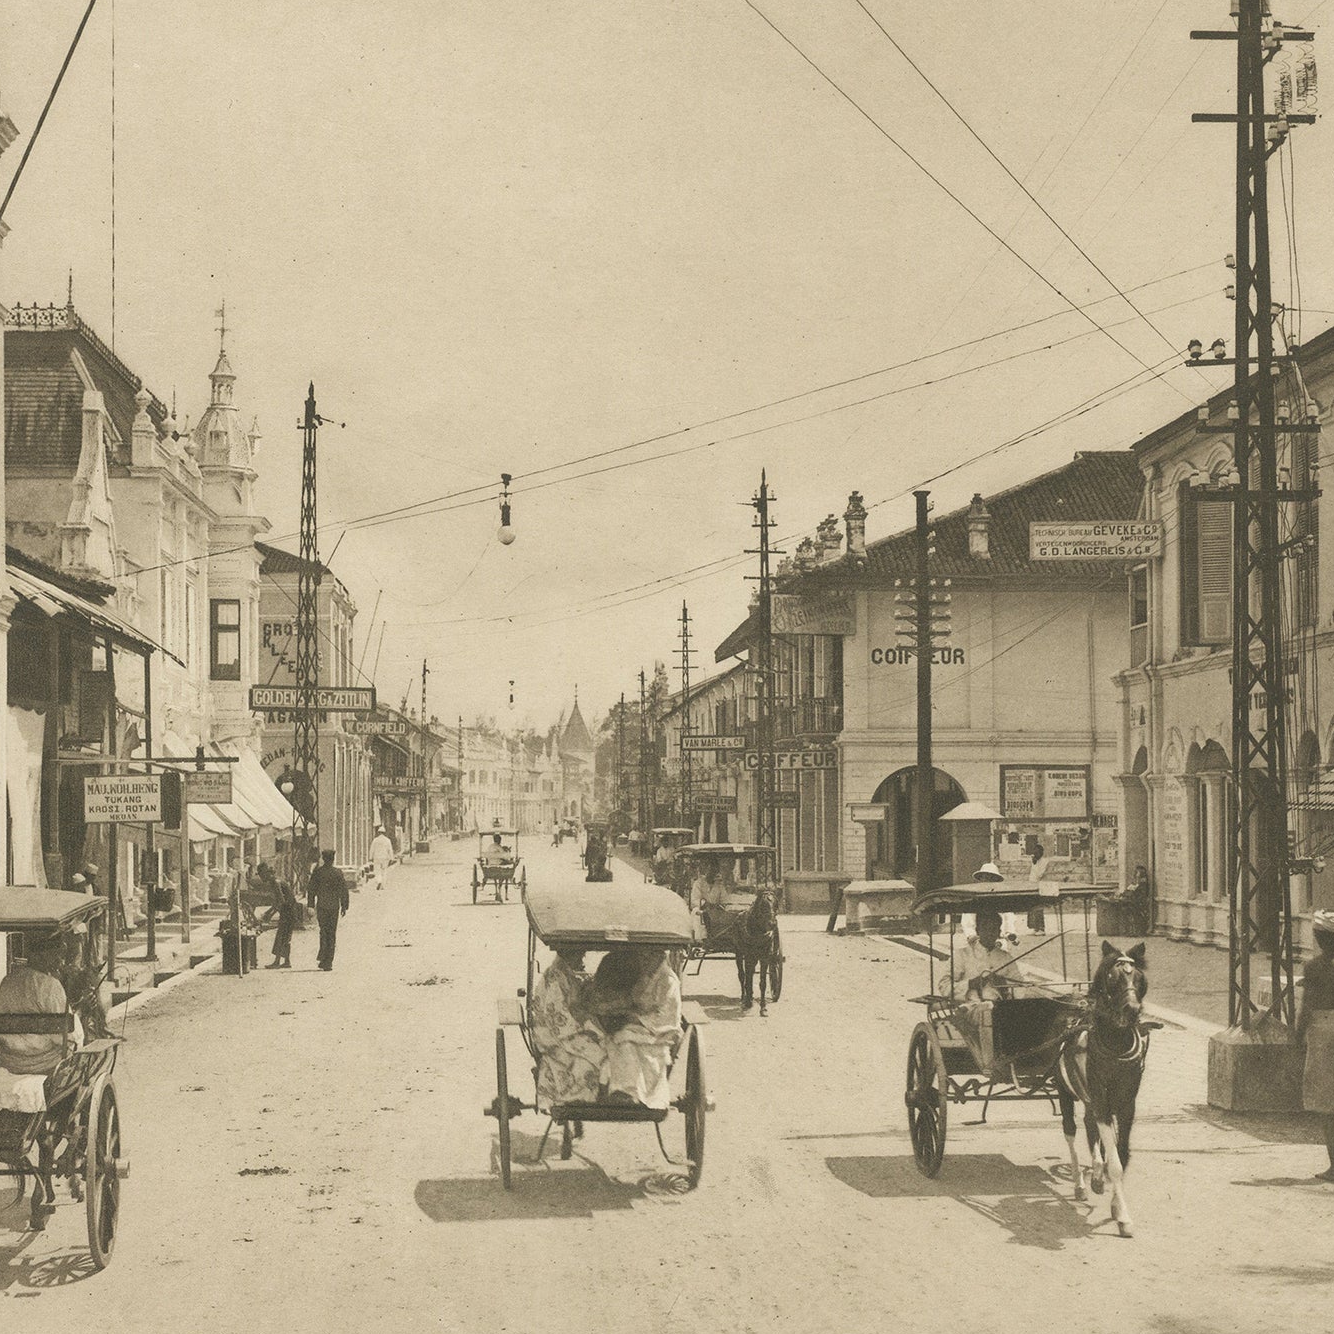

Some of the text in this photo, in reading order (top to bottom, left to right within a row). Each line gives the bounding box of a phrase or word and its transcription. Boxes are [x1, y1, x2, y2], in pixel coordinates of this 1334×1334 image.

[1093, 525, 1136, 536] GEVEKE
[871, 647, 965, 665] COIFEUR
[356, 721, 406, 734] CORNFIELD
[684, 738, 699, 747] VAN
[700, 738, 726, 747] MARLE
[747, 752, 836, 769] COFFEUR
